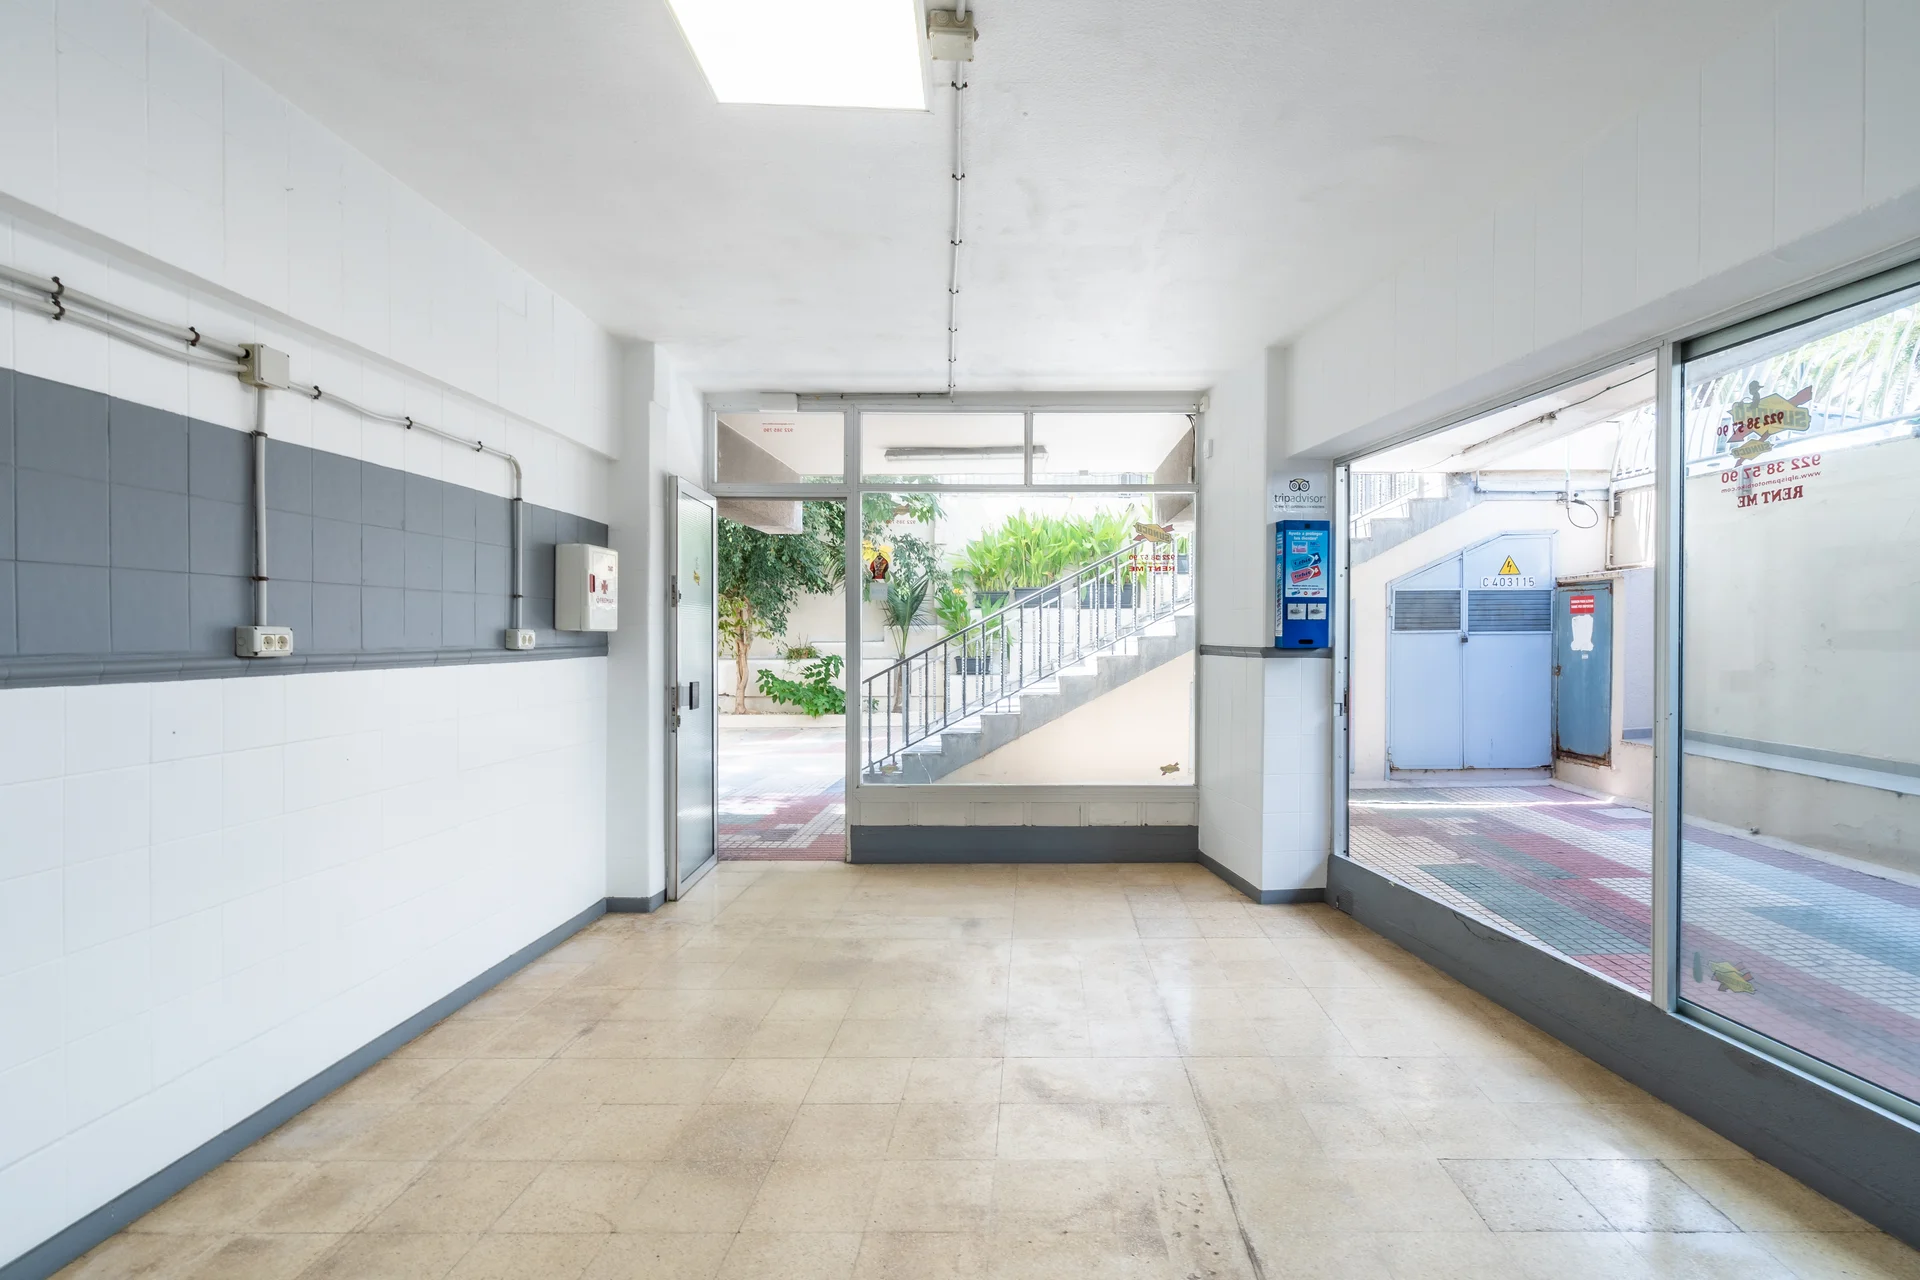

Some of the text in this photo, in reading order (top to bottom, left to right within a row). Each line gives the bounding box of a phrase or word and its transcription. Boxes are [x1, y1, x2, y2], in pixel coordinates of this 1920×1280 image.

[1274, 492, 1324, 504] tripadvisor
[1482, 577, 1535, 587] C 403115
